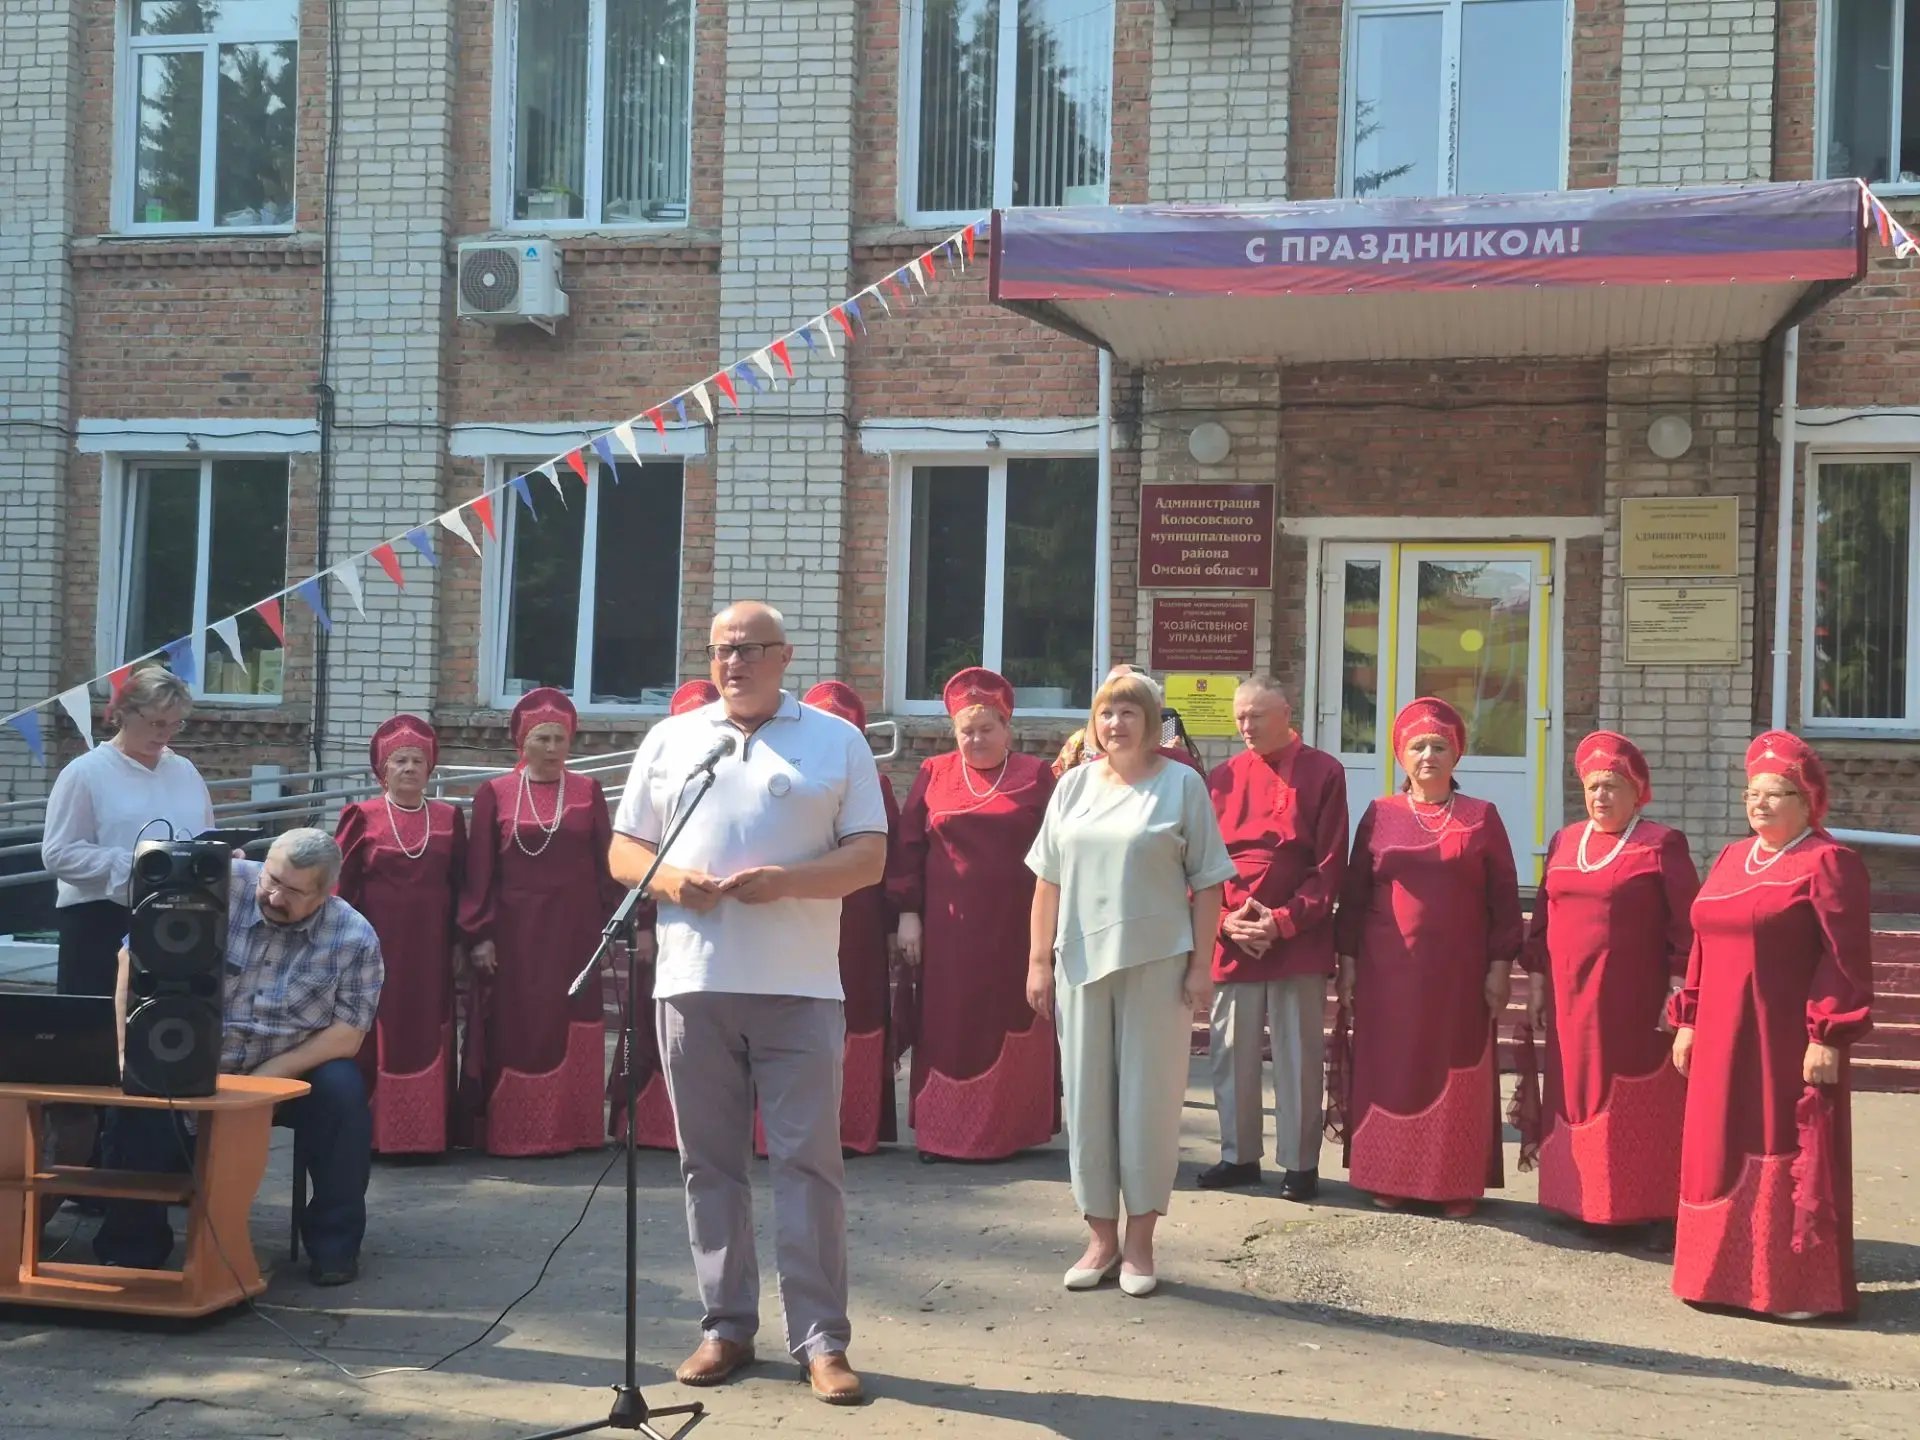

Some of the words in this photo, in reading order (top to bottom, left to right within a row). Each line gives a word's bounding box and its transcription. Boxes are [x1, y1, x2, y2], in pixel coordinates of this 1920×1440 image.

[1245, 237, 1265, 263] С
[1281, 226, 1581, 265] ПРАЗДНИКОМ!
[1155, 497, 1260, 511] Администрация
[1161, 513, 1253, 526] Колосовского
[1151, 532, 1262, 545] муниципального
[1635, 531, 1726, 542] АДМИНИСТРАЦИЯ
[1181, 547, 1229, 561] района
[1151, 563, 1201, 575] Омской
[1159, 620, 1249, 630] "ХОЗЯЙСТВЕННОЕ
[1168, 633, 1238, 643] УПРАВЛЕНИЕ"
